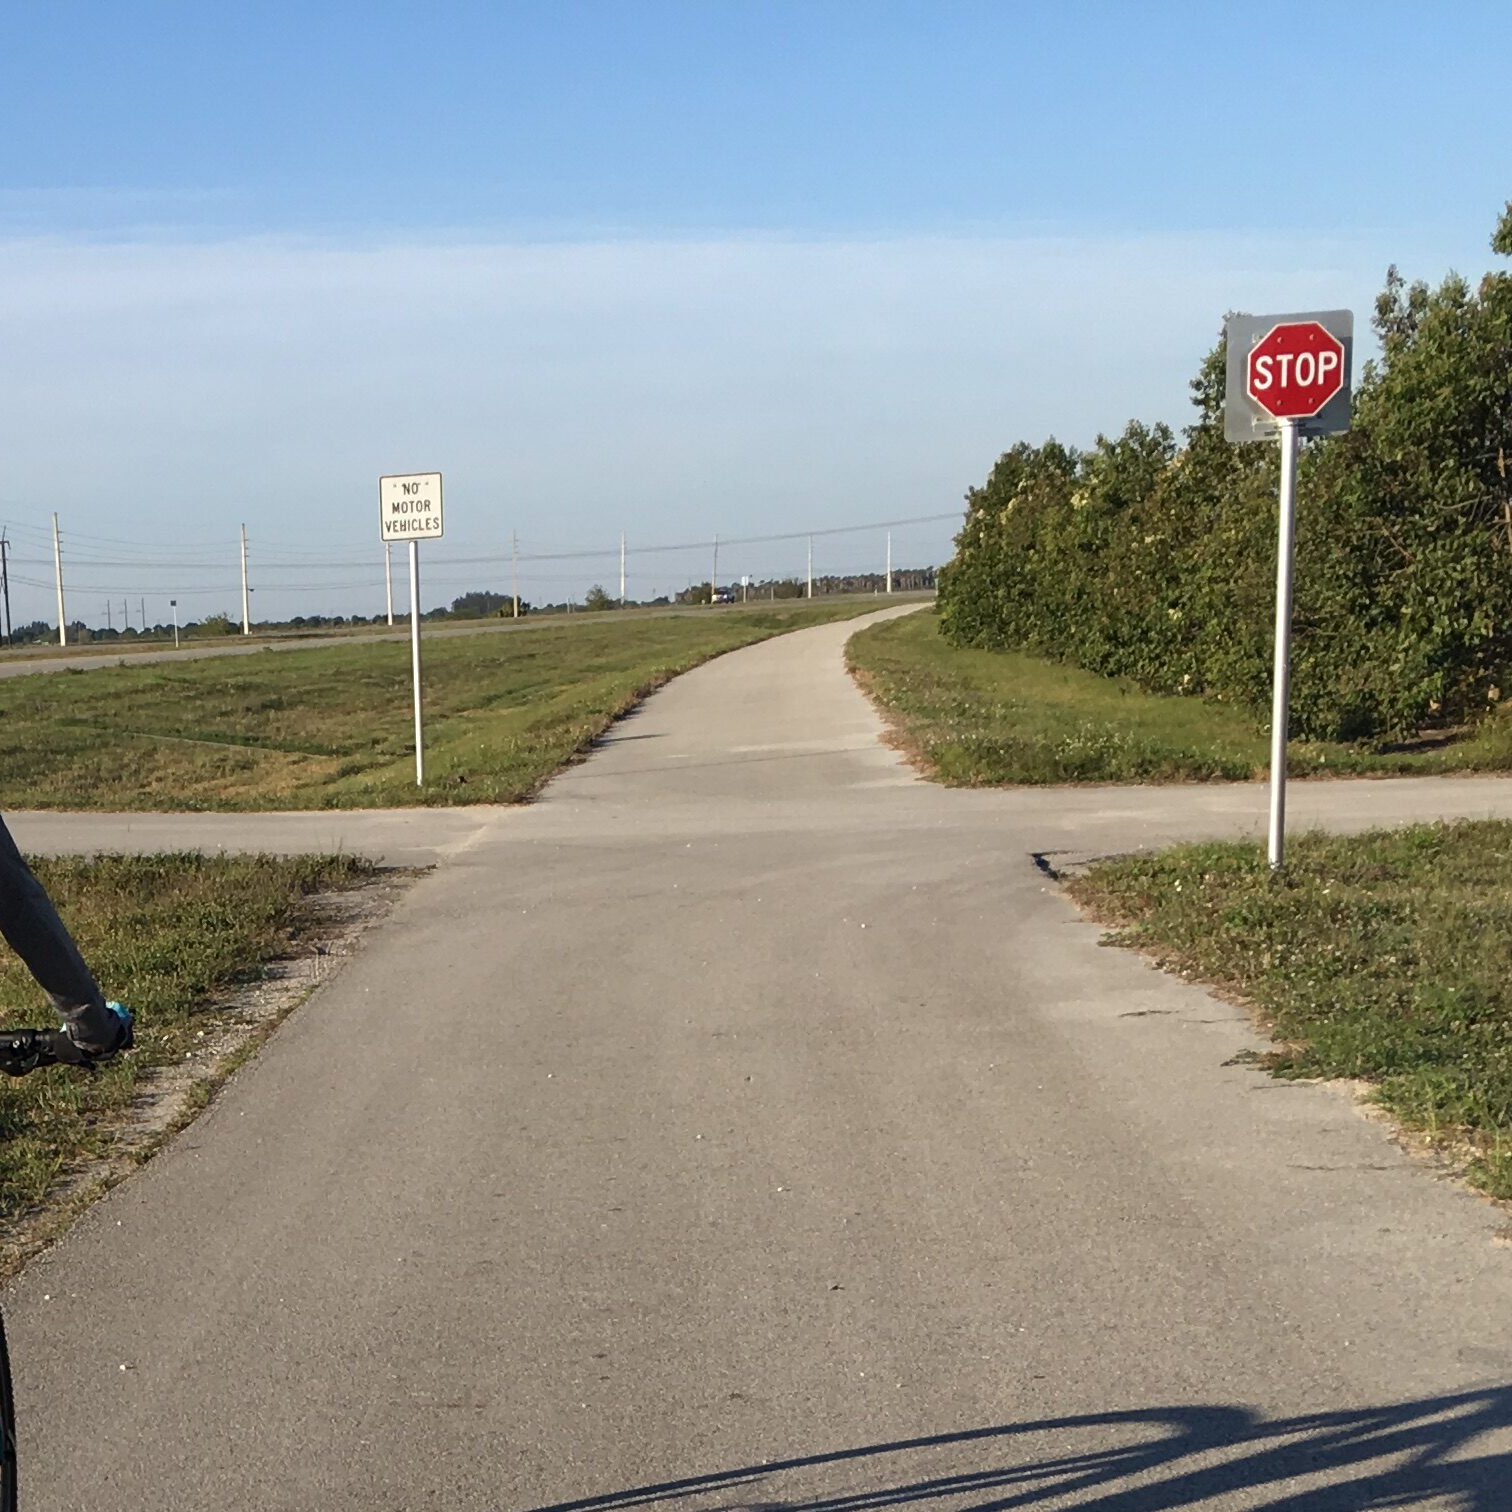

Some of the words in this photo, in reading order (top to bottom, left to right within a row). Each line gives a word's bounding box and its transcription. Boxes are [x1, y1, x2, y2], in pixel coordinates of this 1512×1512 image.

[1253, 350, 1338, 390] STOP
[402, 482, 419, 495] NO
[391, 499, 431, 514] MOTOR
[384, 517, 440, 533] VEHICLES
